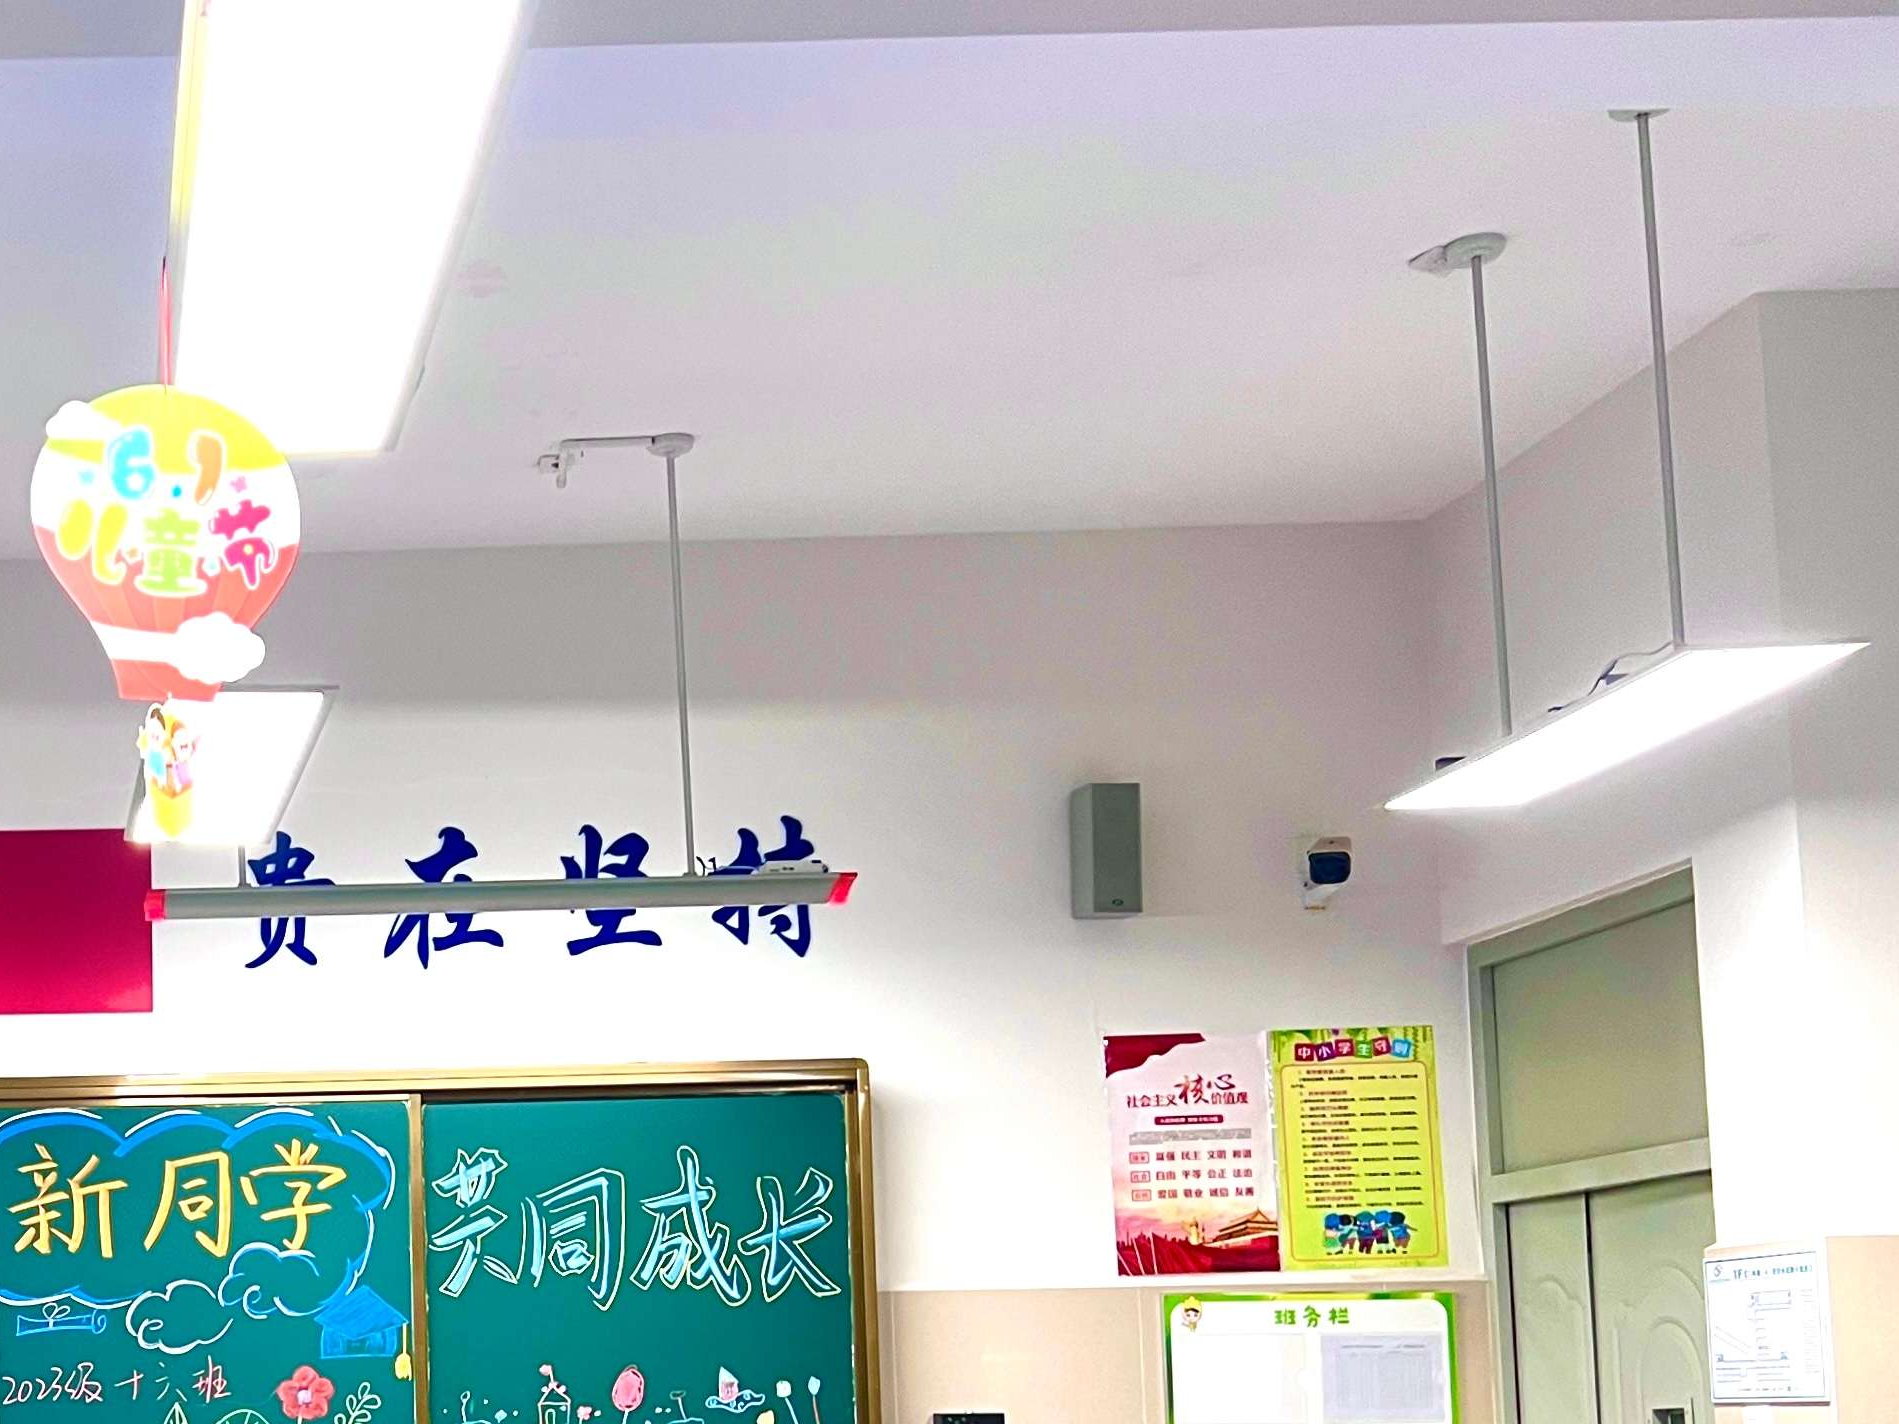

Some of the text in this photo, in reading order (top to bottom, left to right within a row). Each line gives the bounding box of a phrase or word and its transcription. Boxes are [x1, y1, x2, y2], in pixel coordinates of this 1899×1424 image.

[57, 499, 273, 596] 儿童节
[245, 815, 813, 969] 贵在坚持
[8, 1140, 347, 1259] 新同学
[428, 1145, 841, 1309] 共同成长
[1274, 1305, 1350, 1327] 班务栏
